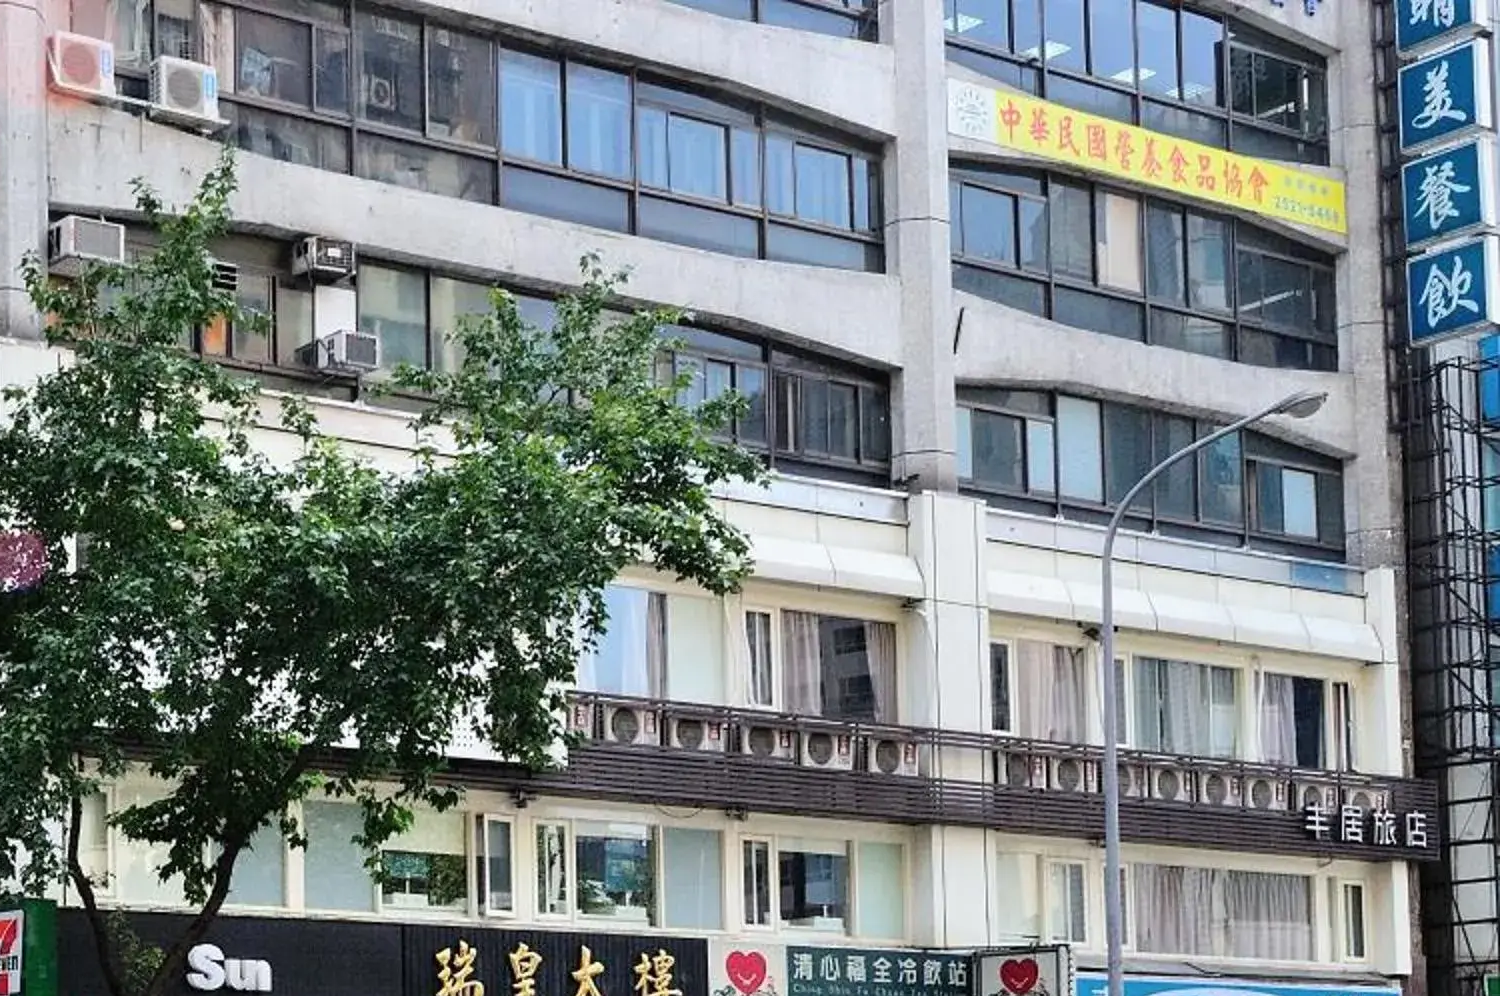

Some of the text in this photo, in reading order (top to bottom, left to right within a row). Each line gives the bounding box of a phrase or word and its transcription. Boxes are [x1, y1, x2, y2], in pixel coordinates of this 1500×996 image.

[999, 99, 1269, 205] 中華民國營養食品協會
[185, 943, 274, 993] Sun
[793, 953, 968, 987] 清心福全冷飲站
